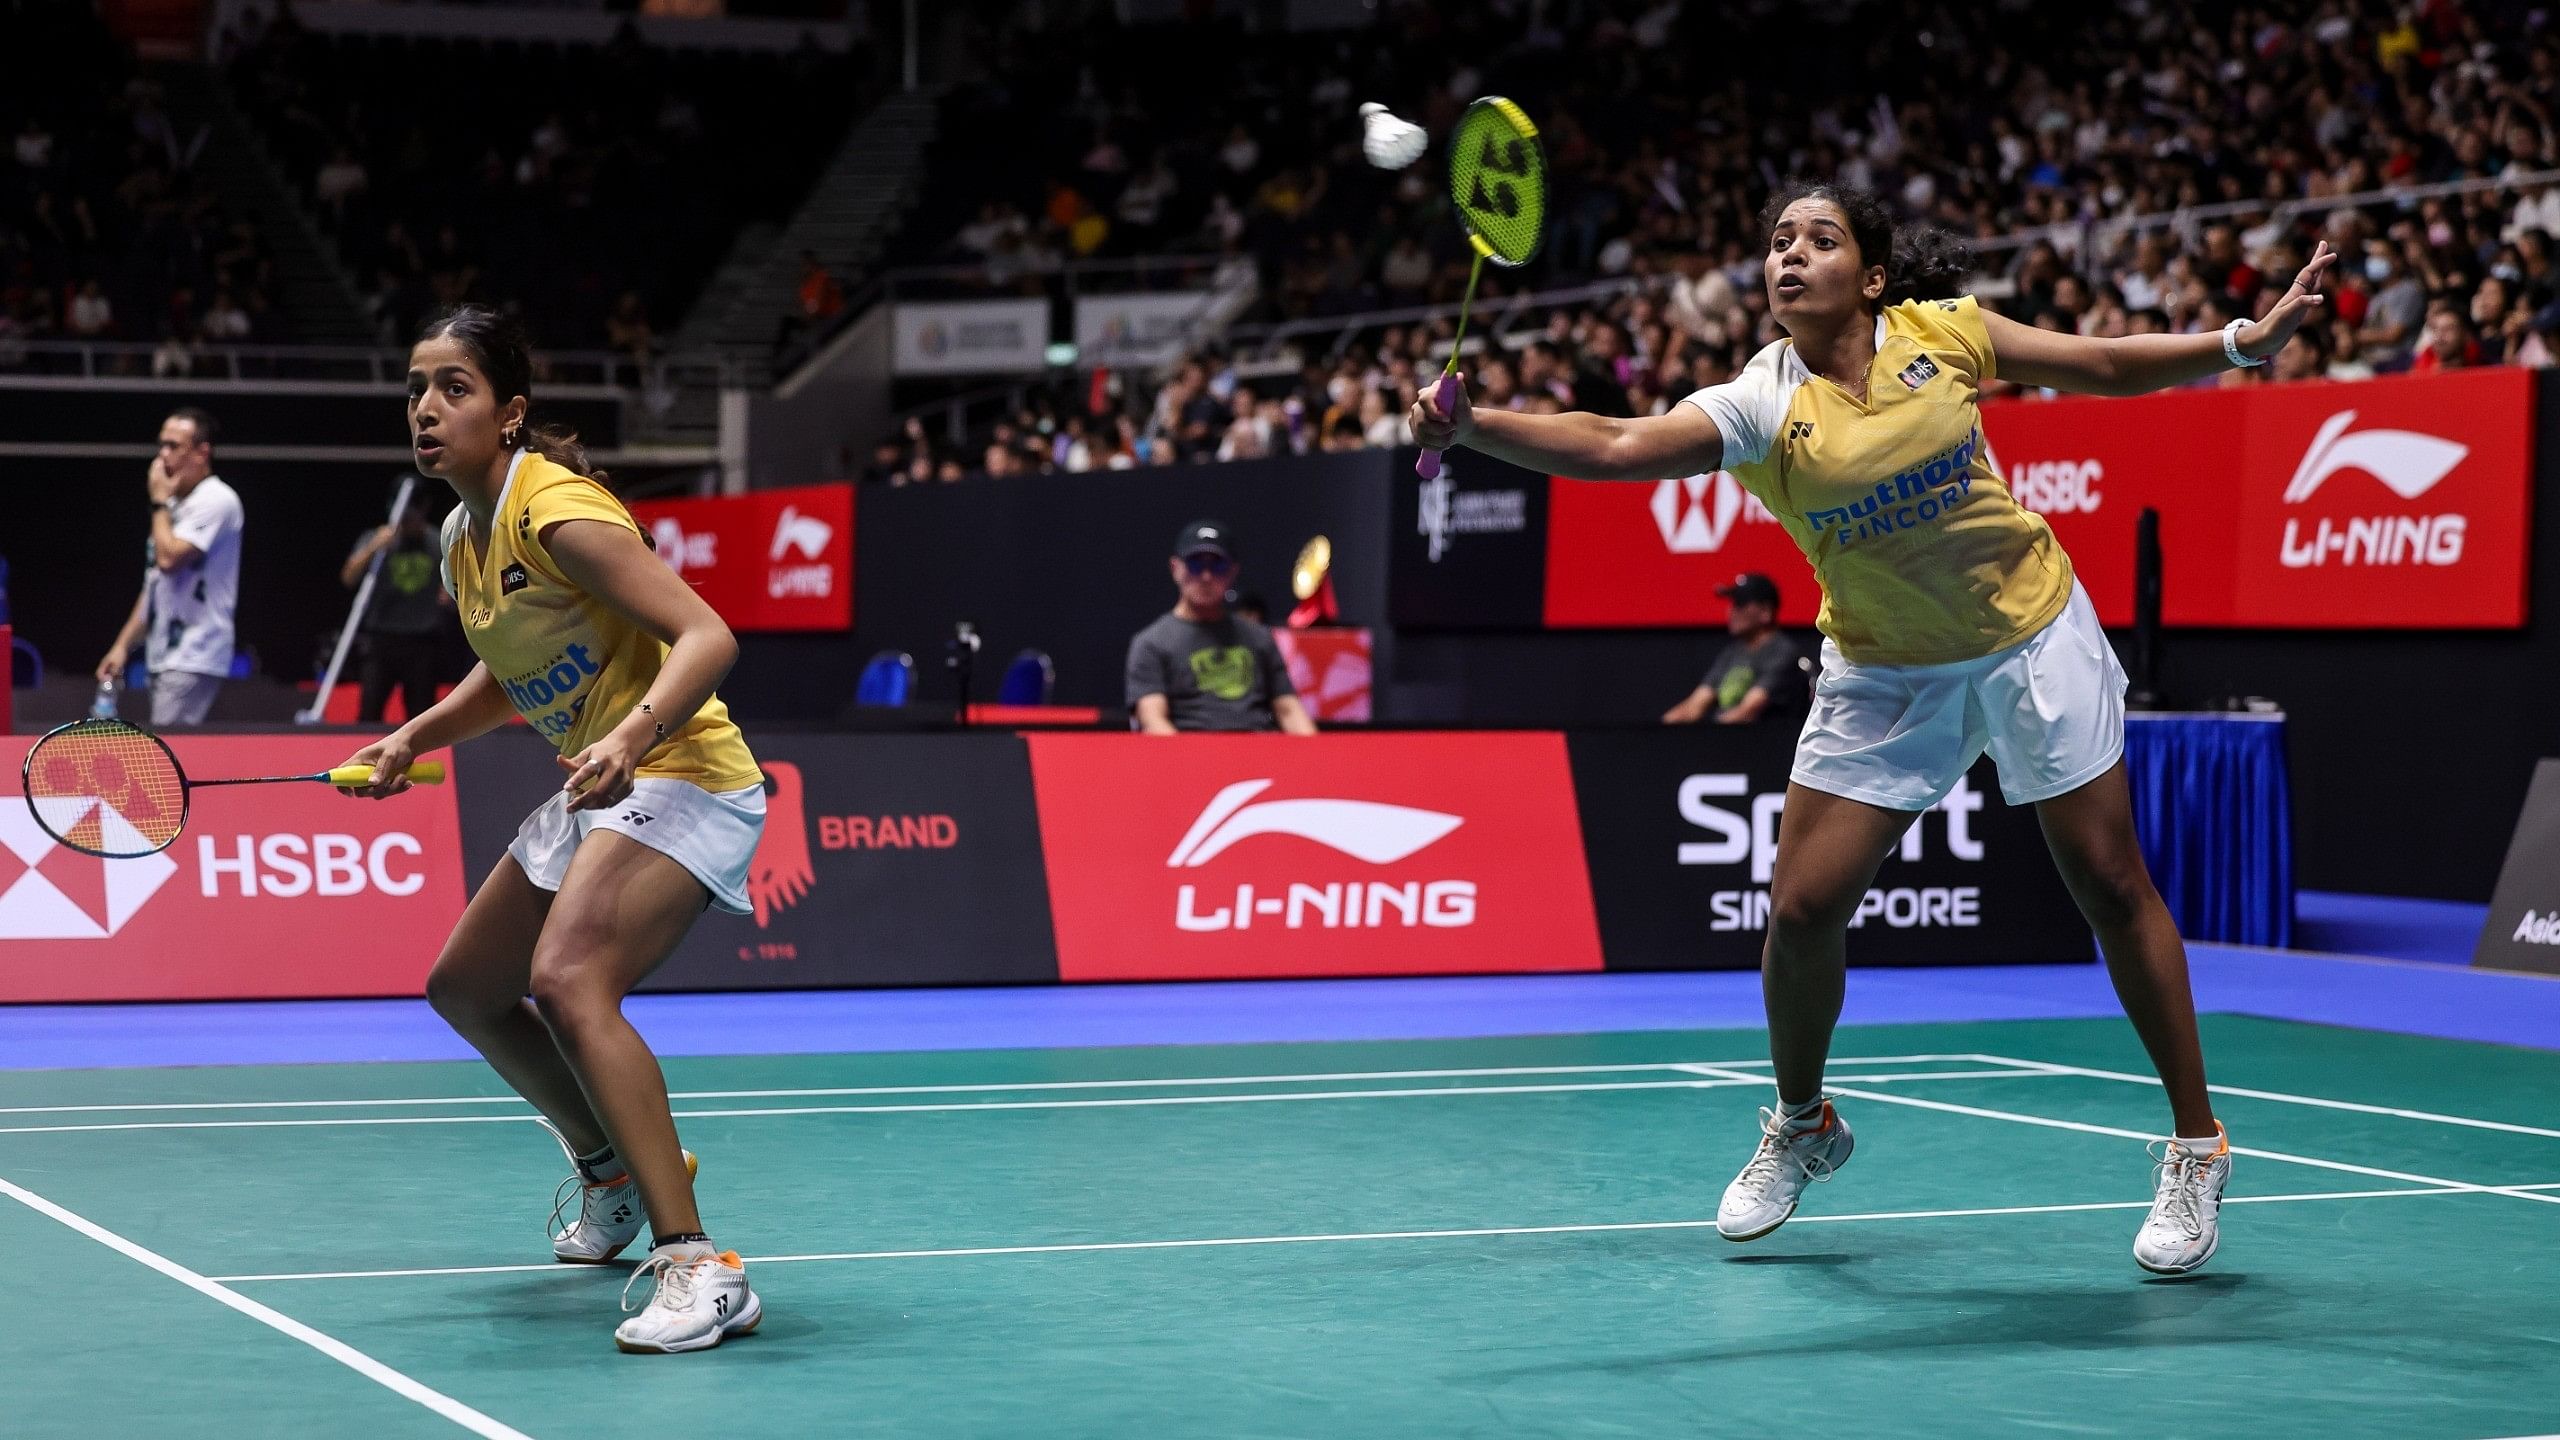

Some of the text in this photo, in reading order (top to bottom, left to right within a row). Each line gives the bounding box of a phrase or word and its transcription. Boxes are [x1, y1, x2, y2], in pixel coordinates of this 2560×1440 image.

[1911, 360, 1933, 380] DBS
[1838, 470, 1971, 545] FINCORP
[2012, 459, 2103, 513] HSBC
[2281, 514, 2466, 565] LI-NING
[500, 642, 600, 713] thoot
[818, 815, 959, 850] BRAND
[1677, 773, 1984, 884] Sprt
[199, 832, 425, 897] HSBC
[1175, 880, 1477, 931] LI-NING
[1710, 887, 1981, 931] SINPORE
